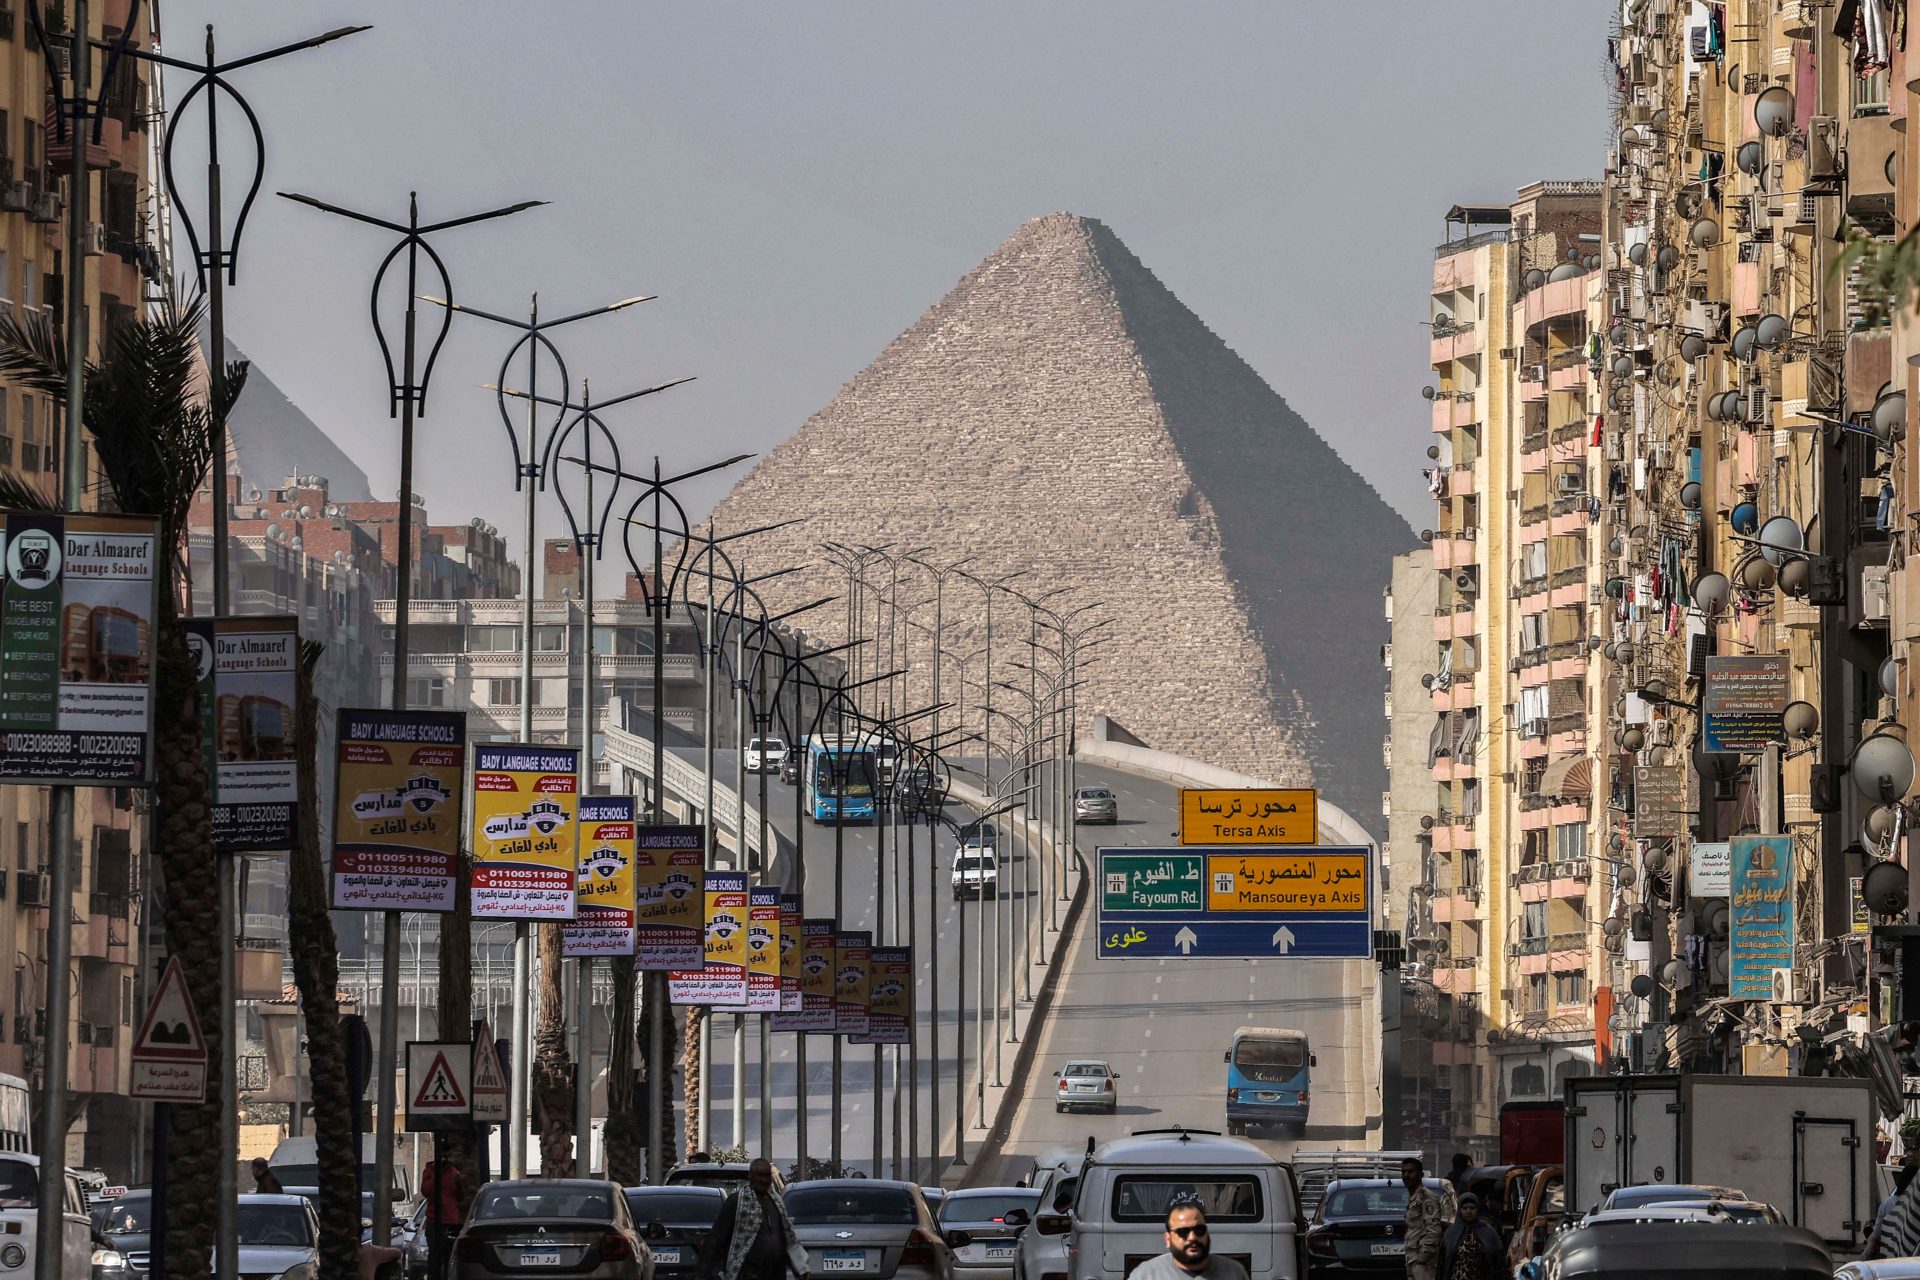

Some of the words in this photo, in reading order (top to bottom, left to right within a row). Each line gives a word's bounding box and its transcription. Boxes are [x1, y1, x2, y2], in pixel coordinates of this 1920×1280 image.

[67, 540, 87, 557] Dar
[92, 540, 148, 558] Almaaref
[66, 561, 108, 575] Language
[112, 562, 148, 575] Schools
[9, 600, 27, 612] THE
[30, 601, 53, 613] BEST
[4, 617, 41, 626] GUIDELINE
[42, 618, 57, 626] FOR
[13, 631, 32, 640] YOUR
[33, 632, 49, 640] KIDS
[218, 640, 236, 654] Dar
[239, 638, 287, 654] Almaaref
[217, 658, 253, 670] Language
[257, 657, 287, 667] Schools
[351, 723, 373, 739] BADY
[374, 724, 416, 741] LANGUAGE
[418, 726, 454, 742] SCHOOLS
[7, 734, 71, 753] 01023088988
[80, 736, 141, 755] 01023200991
[79, 757, 111, 766] الدكتور
[113, 757, 134, 767] شارع
[419, 757, 442, 766] طالب
[482, 755, 501, 769] BADY
[502, 756, 539, 770] LANGUAGE
[540, 757, 573, 771] SCHOOLS
[541, 785, 562, 793] طالب
[355, 794, 402, 812] مدارس
[420, 800, 427, 808] S
[1199, 796, 1241, 819] ترسا
[237, 806, 290, 823] 01023200991
[599, 807, 628, 820] SCHOOLS
[1247, 801, 1297, 819] محور
[238, 825, 264, 833] الدكتور
[266, 824, 285, 833] شارع
[370, 818, 406, 835] للغات
[410, 817, 436, 835] بادي
[486, 818, 527, 834] مدارس
[1213, 825, 1253, 837] Tersa
[1257, 825, 1286, 837] Axis
[500, 840, 531, 854] للغات
[535, 838, 557, 854] بادي
[642, 836, 671, 848] LANGUAGE
[672, 836, 698, 848] SCHOOLS
[358, 853, 447, 864] 01100511980
[358, 864, 447, 875] 01033948000
[489, 870, 567, 879] 01100511980
[1133, 862, 1175, 888] الفيوم
[1239, 860, 1316, 886] المنصورية
[1322, 866, 1361, 885] محور
[489, 880, 567, 889] 01033948000
[578, 883, 594, 896] للغا
[597, 881, 617, 895] بادي
[718, 880, 742, 891] SCHOOLS
[751, 894, 774, 905] SCHOOLS
[1133, 891, 1179, 907] Fayoum
[1181, 891, 1199, 903] Rd.
[1239, 891, 1326, 906] Mansoureya
[1331, 891, 1361, 903] Axis
[642, 905, 667, 918] للغات
[669, 903, 688, 916] بادي
[809, 925, 829, 935] SCHOOLS
[1105, 926, 1148, 948] علوى
[716, 941, 733, 953] بادي
[104, 1188, 123, 1196] TAXI
[824, 1259, 844, 1269] ٦٦٩٥
